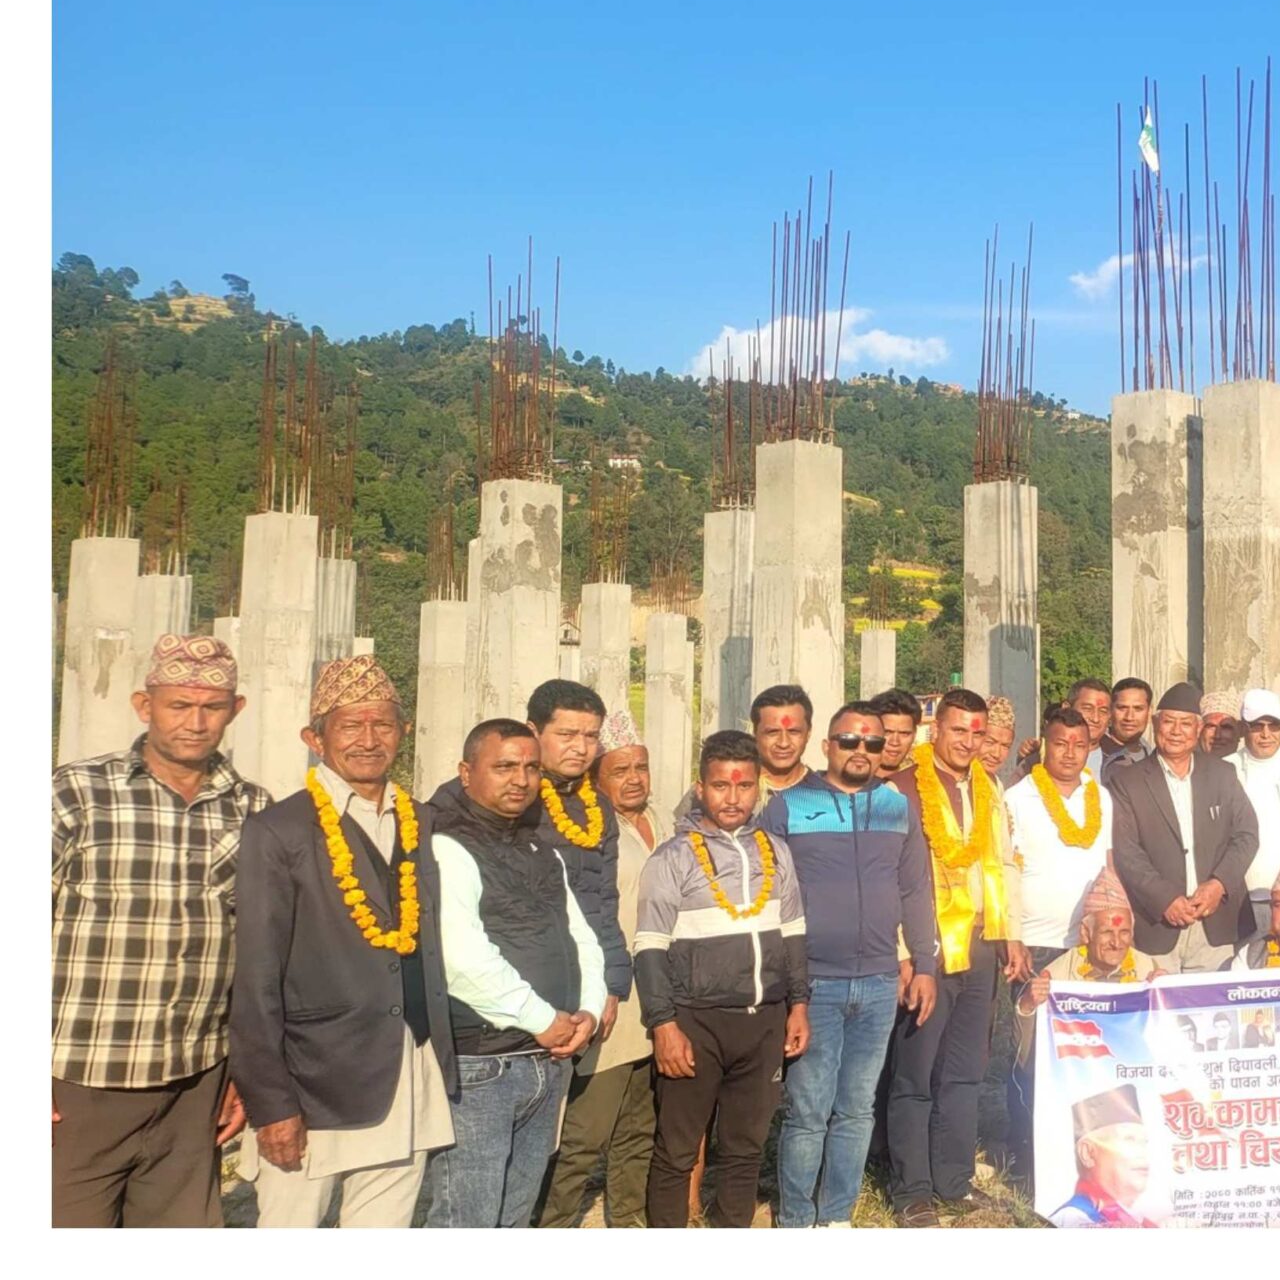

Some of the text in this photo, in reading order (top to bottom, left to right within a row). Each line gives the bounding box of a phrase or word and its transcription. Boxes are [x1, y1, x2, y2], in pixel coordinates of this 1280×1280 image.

[1116, 1064, 1153, 1079] विजया
[1202, 1061, 1223, 1078] शुभ
[1209, 1076, 1226, 1091] को
[1230, 1075, 1261, 1090] पावन
[1171, 1141, 1231, 1174] तथा
